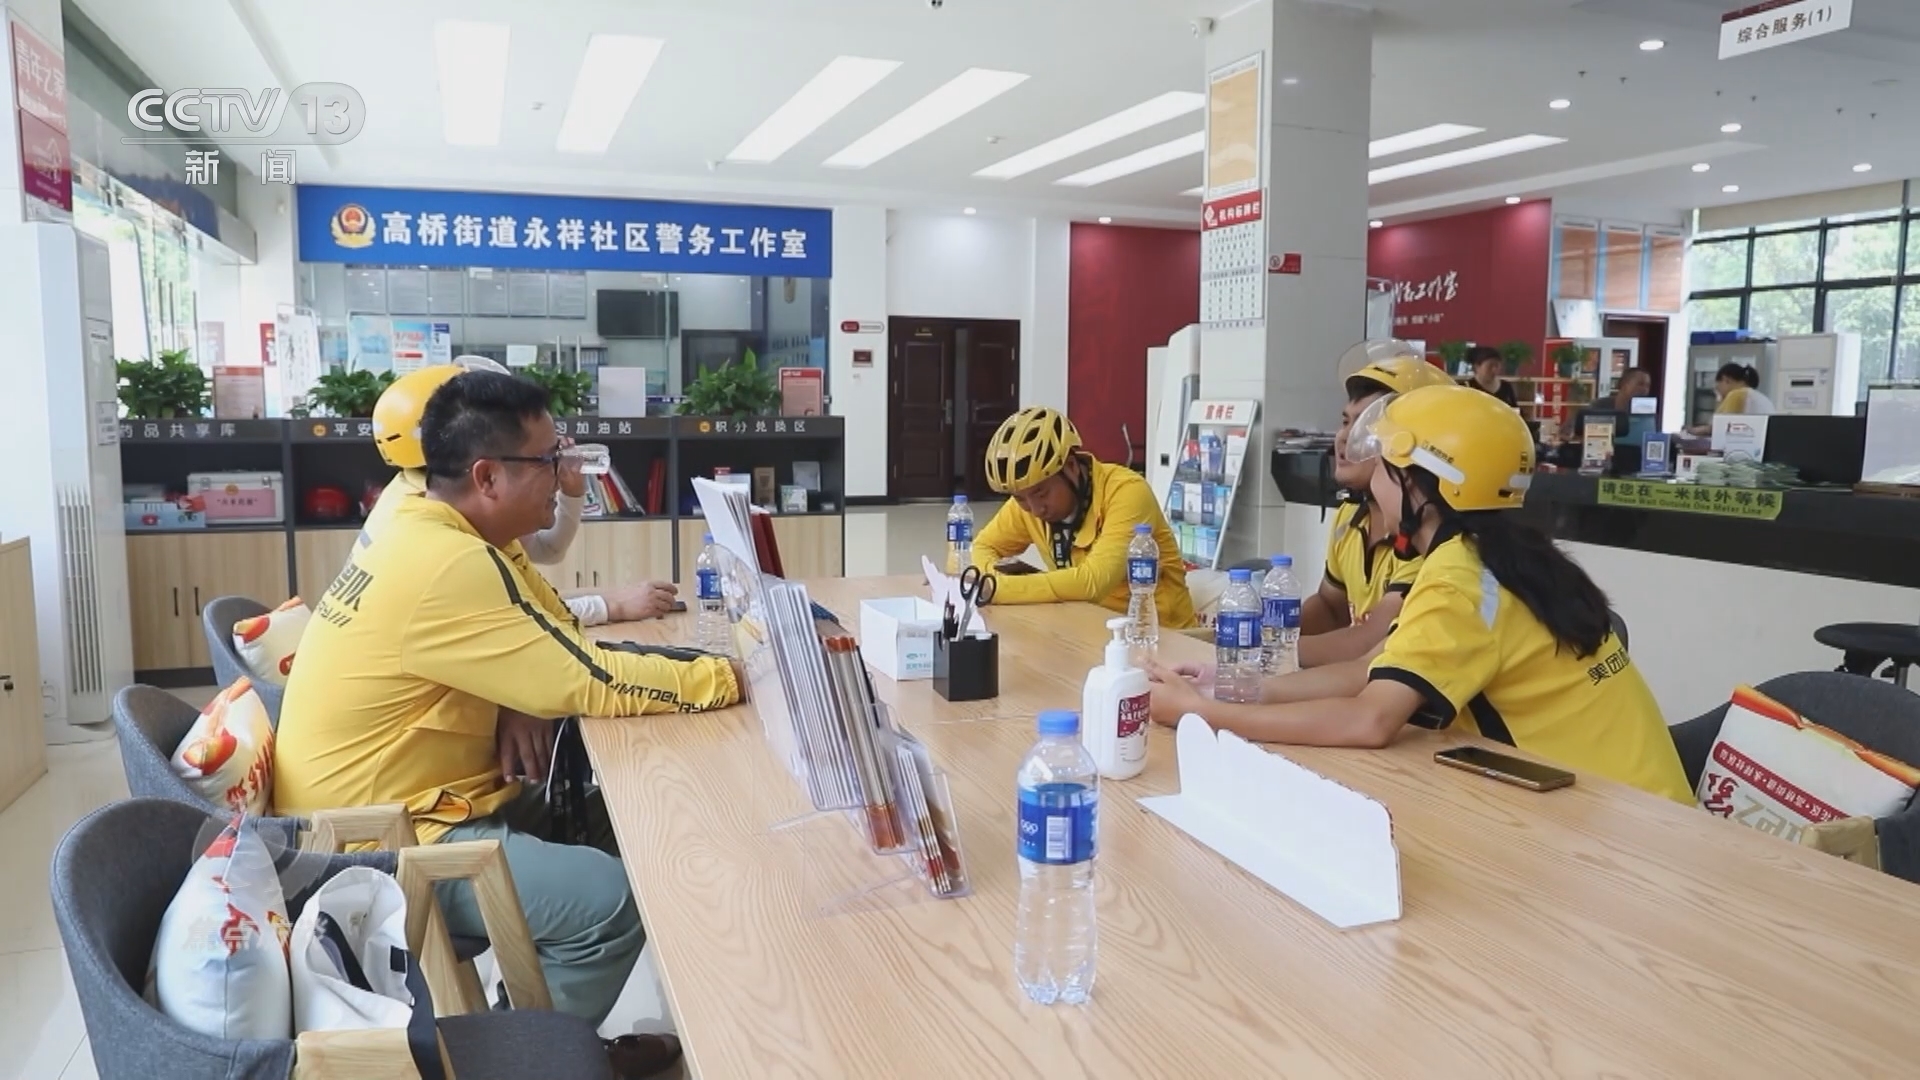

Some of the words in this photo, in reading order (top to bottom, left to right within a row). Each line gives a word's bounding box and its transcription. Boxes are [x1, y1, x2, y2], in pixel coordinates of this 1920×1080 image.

[1737, 6, 1832, 43] 综合服务(1)
[381, 211, 808, 259] 高桥街道永祥社区警务工作室
[715, 421, 806, 434] 积分兑换区
[1602, 481, 1777, 509] 请您在一米线外等候
